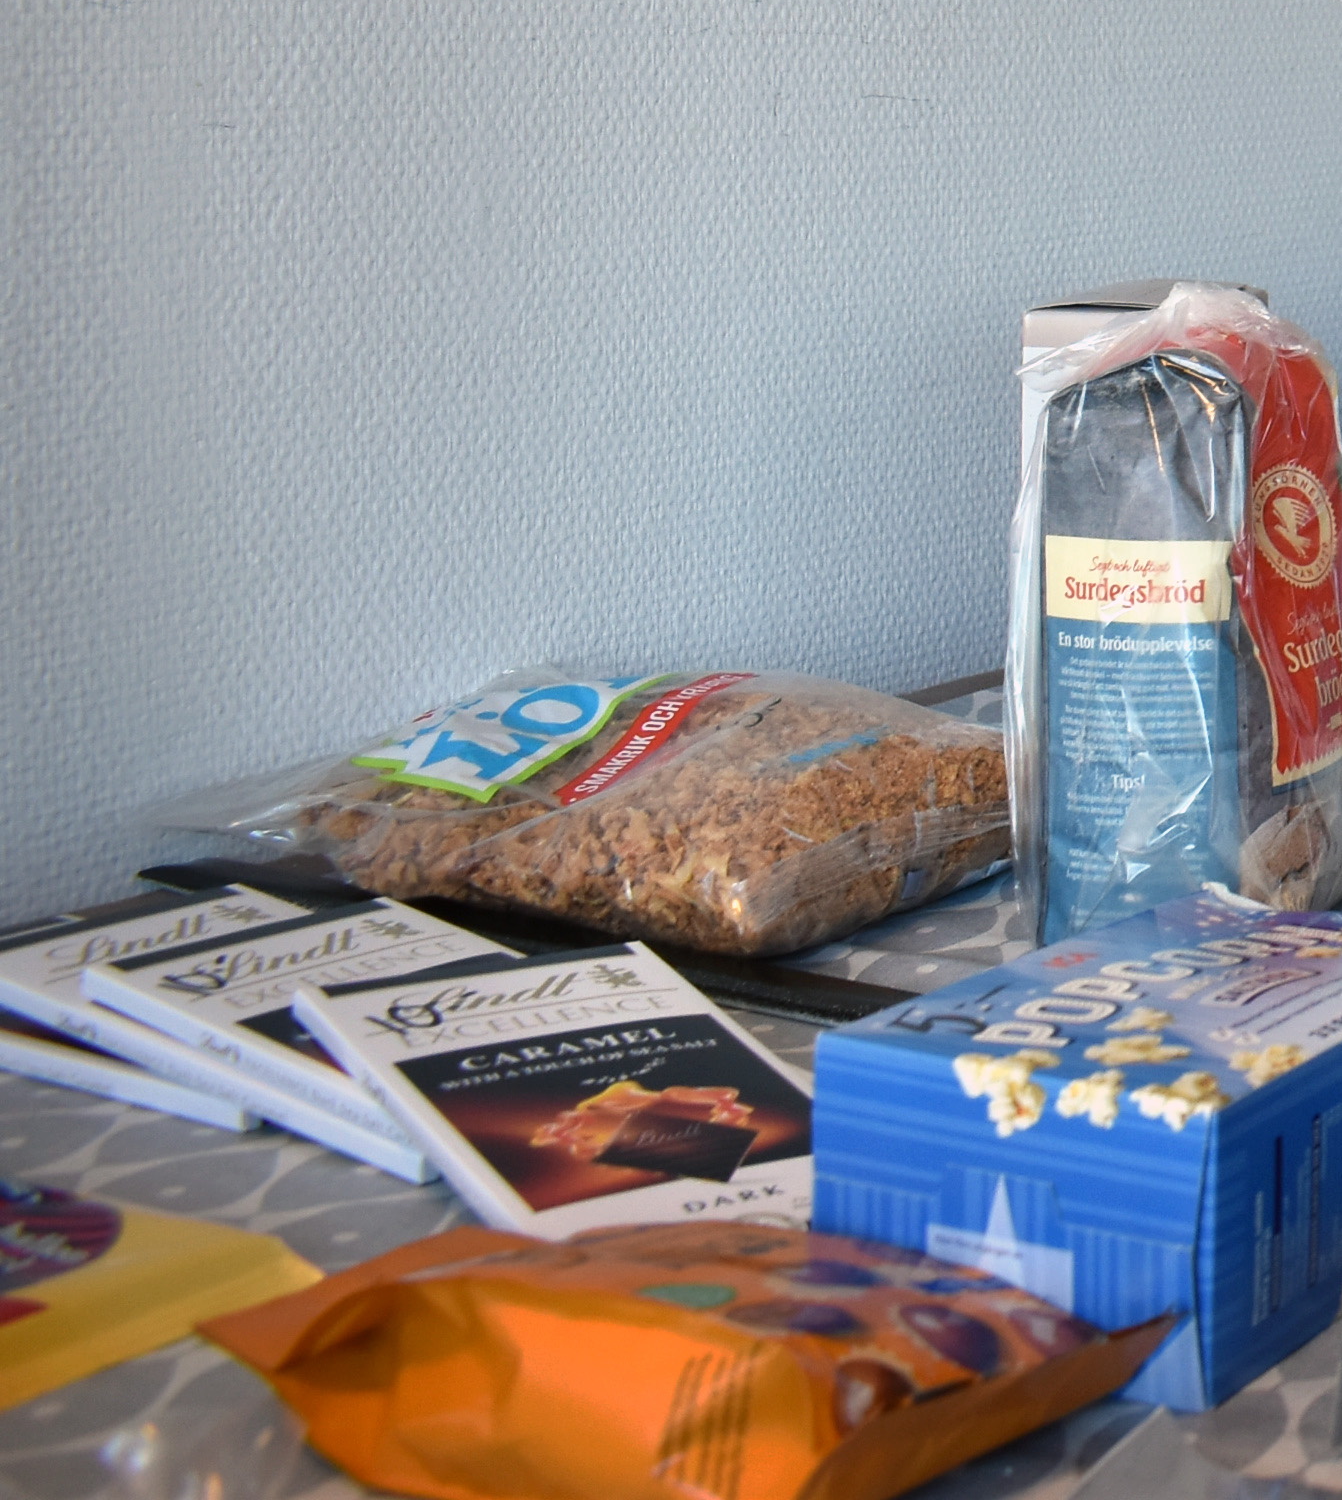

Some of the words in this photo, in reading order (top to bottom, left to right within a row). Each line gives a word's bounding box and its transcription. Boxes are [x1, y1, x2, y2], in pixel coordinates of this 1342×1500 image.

[1065, 577, 1206, 609] Surdegsbröd
[1059, 631, 1072, 648] En
[1074, 634, 1095, 649] stor
[1100, 635, 1214, 654] brödupplevelse
[574, 733, 653, 794] SMAKRIK
[642, 699, 680, 737] OCH
[1111, 773, 1145, 791] Tips!
[47, 913, 216, 974] Lindt
[205, 927, 361, 983] Lindt
[386, 963, 592, 1022] Lindt
[402, 995, 676, 1049] EXCELLENCE
[458, 1024, 677, 1073] CARAMEL
[683, 1184, 785, 1215] DARK
